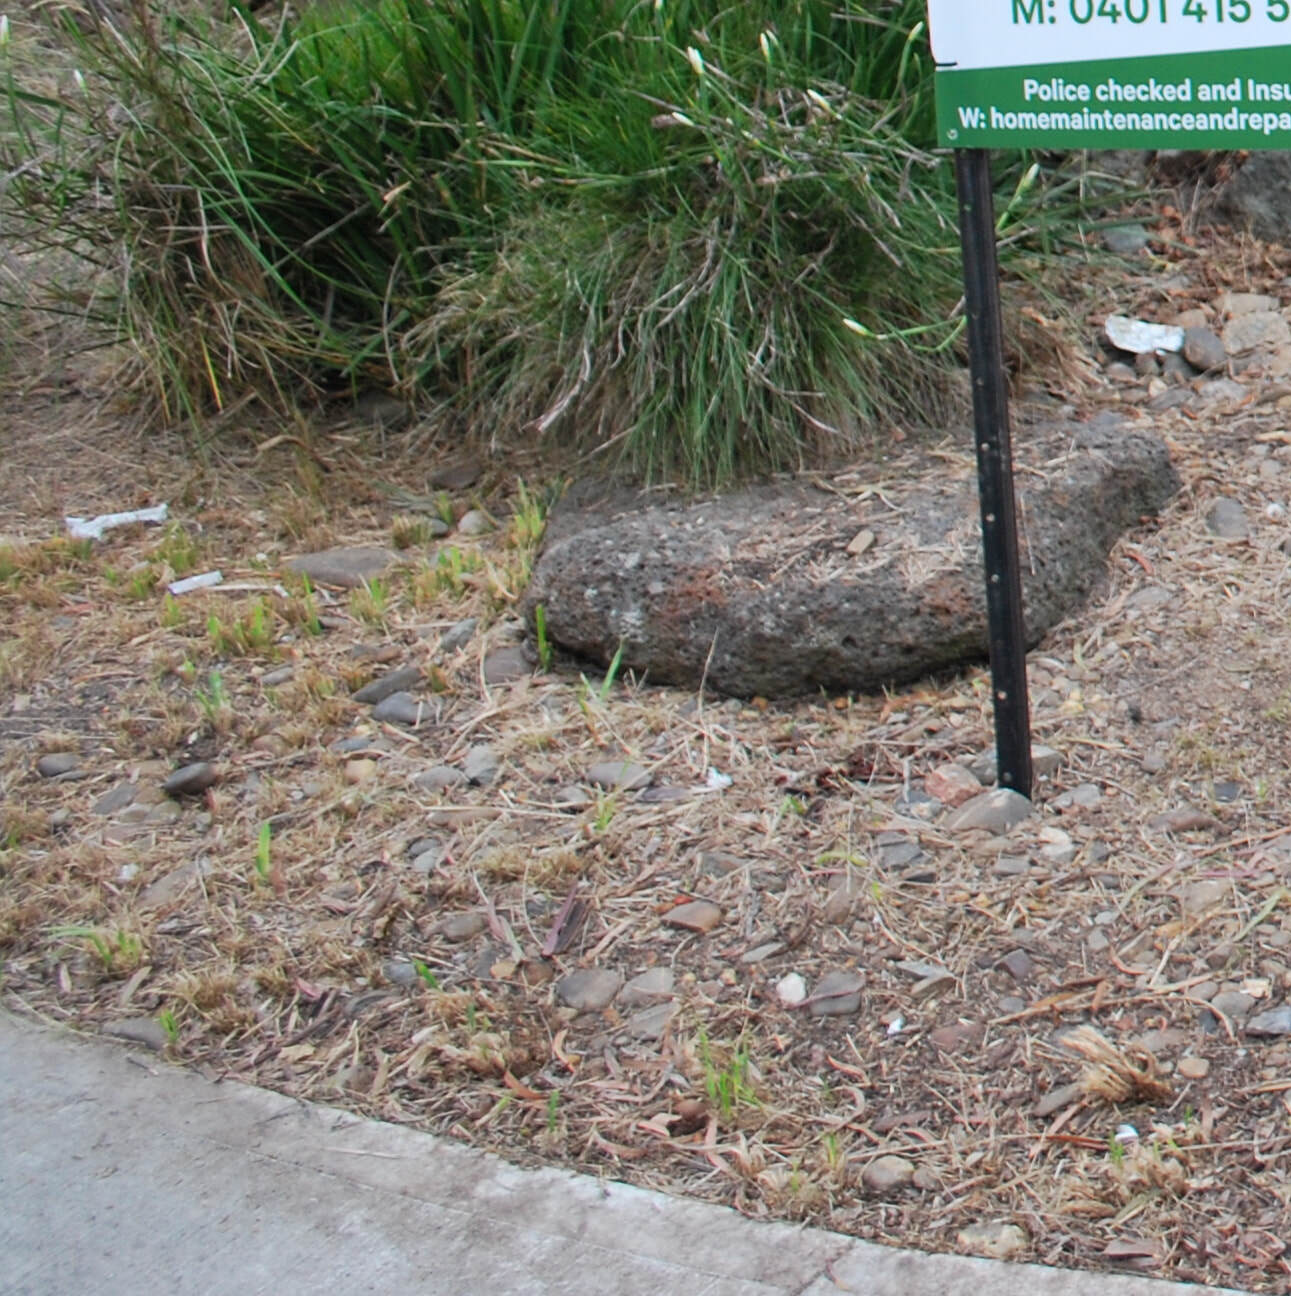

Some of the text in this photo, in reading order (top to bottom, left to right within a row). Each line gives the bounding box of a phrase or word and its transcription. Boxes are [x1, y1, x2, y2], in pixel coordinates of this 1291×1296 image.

[1023, 79, 1090, 102] Police
[1095, 79, 1193, 101] checked
[1198, 77, 1243, 101] and
[958, 108, 986, 128] W:
